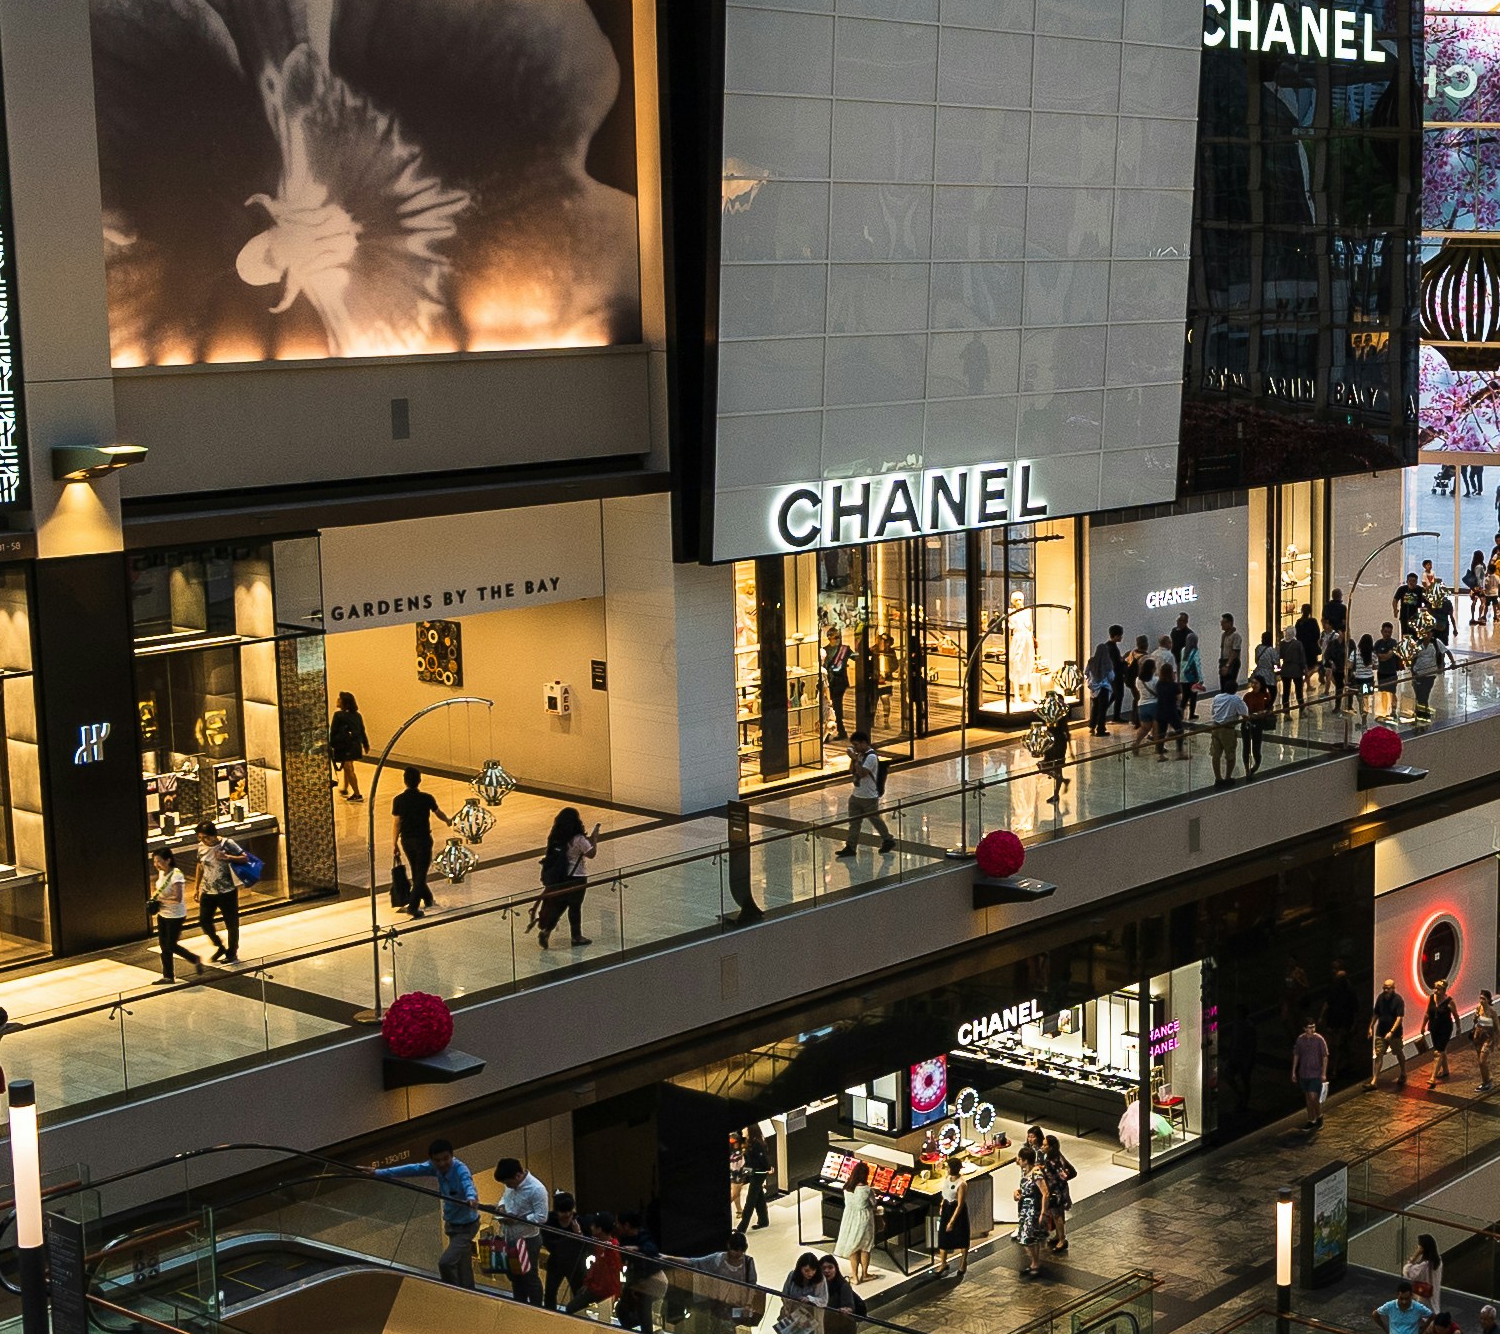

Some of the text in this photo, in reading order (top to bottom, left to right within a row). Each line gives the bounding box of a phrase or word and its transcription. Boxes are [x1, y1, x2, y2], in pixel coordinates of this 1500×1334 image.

[778, 464, 1048, 548] CHANEL
[331, 594, 433, 622] GARDENS
[443, 588, 467, 607] BY
[476, 582, 514, 602] THE
[524, 576, 561, 595] BAY
[1145, 584, 1198, 609] CHANEL
[562, 687, 570, 712] AED
[957, 999, 1044, 1046] CHANEL
[1149, 1018, 1181, 1041] HANCE
[1149, 1037, 1181, 1058] HANEL
